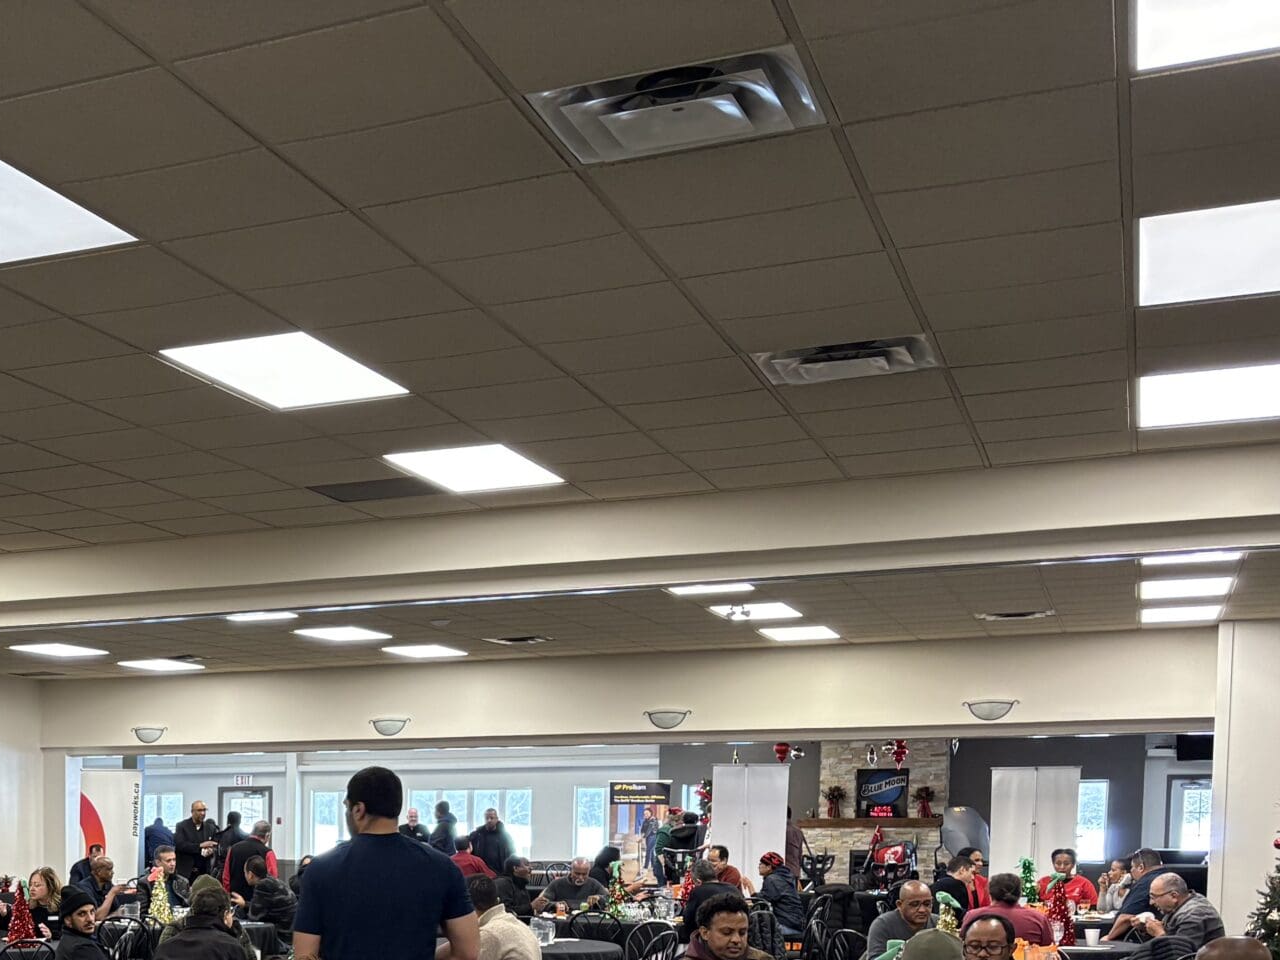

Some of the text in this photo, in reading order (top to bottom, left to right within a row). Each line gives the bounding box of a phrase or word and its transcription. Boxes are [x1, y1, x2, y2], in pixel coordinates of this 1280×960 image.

[236, 775, 250, 785] EXIT
[861, 776, 907, 796] BLUE MOON
[132, 783, 140, 837] payworks.ca
